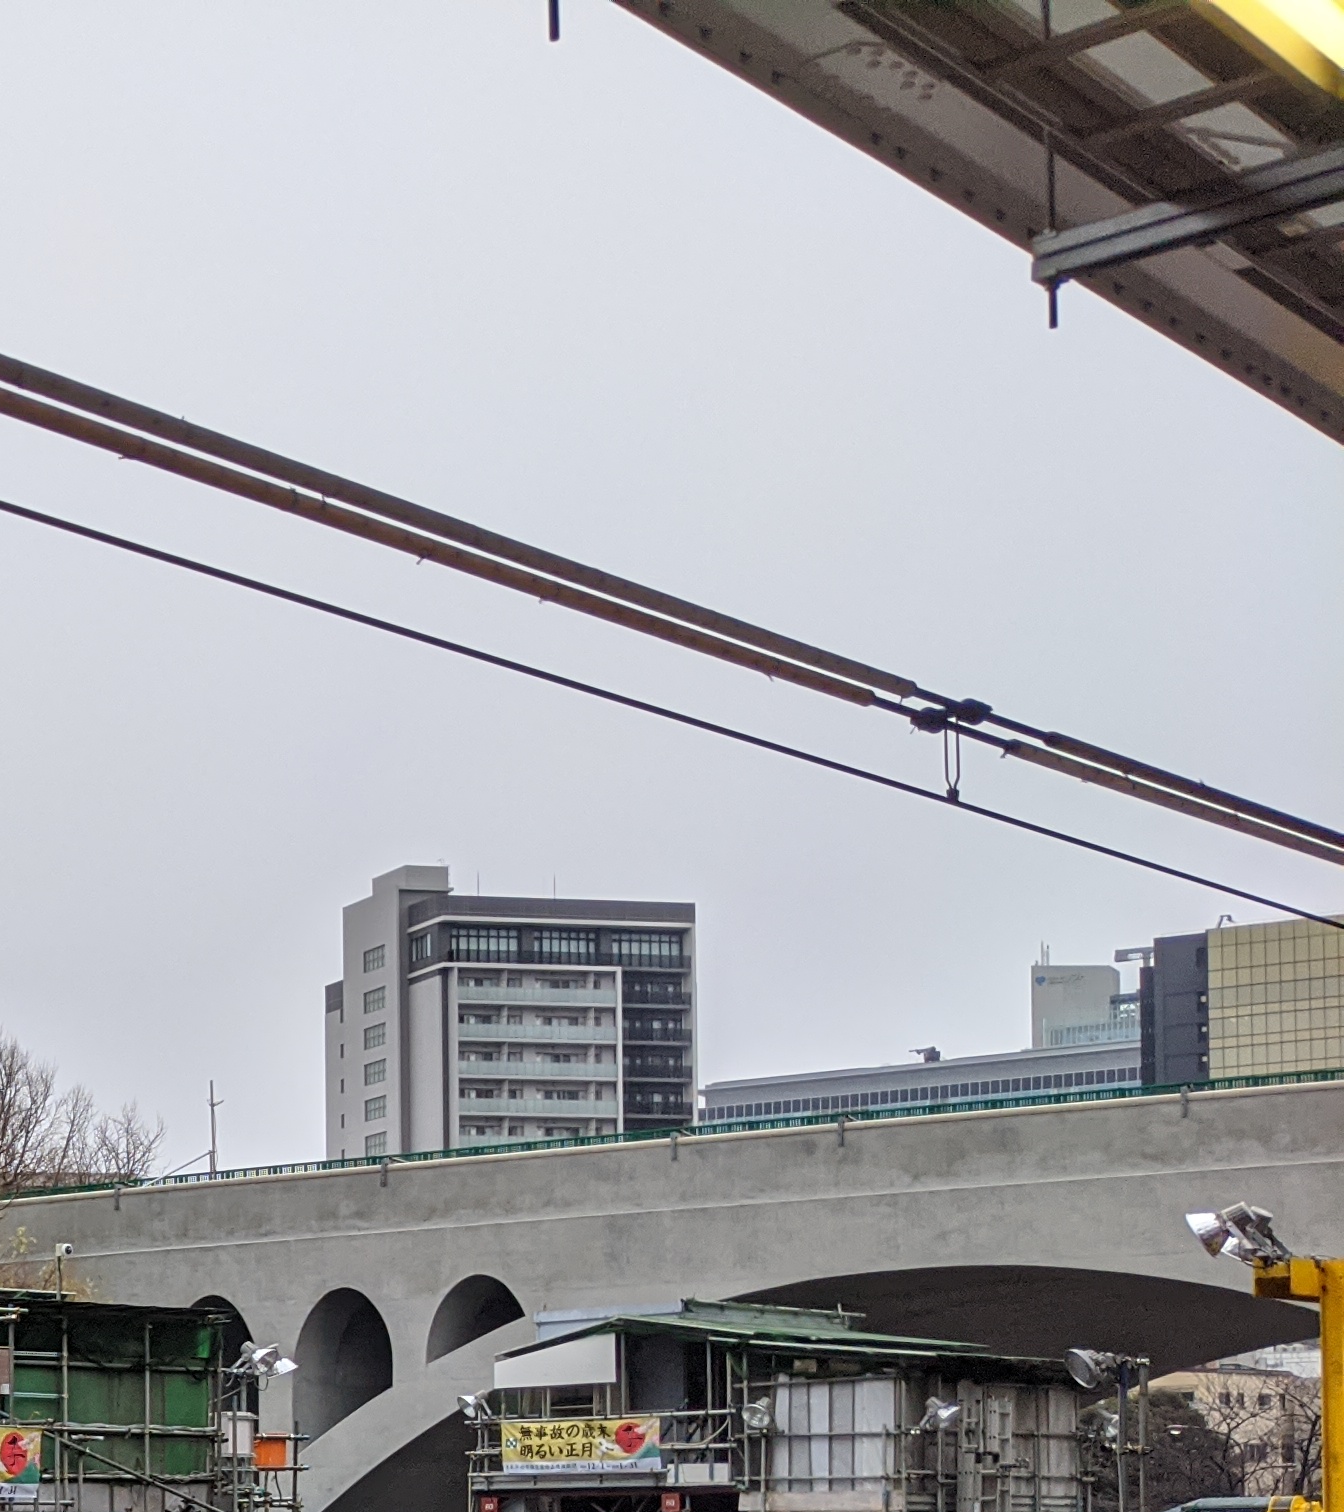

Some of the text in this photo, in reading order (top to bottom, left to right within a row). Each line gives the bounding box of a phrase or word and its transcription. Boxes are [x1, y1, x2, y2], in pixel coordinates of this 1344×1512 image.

[518, 1423, 612, 1441] 無事故の歳末
[519, 1442, 594, 1459] 明るい正月
